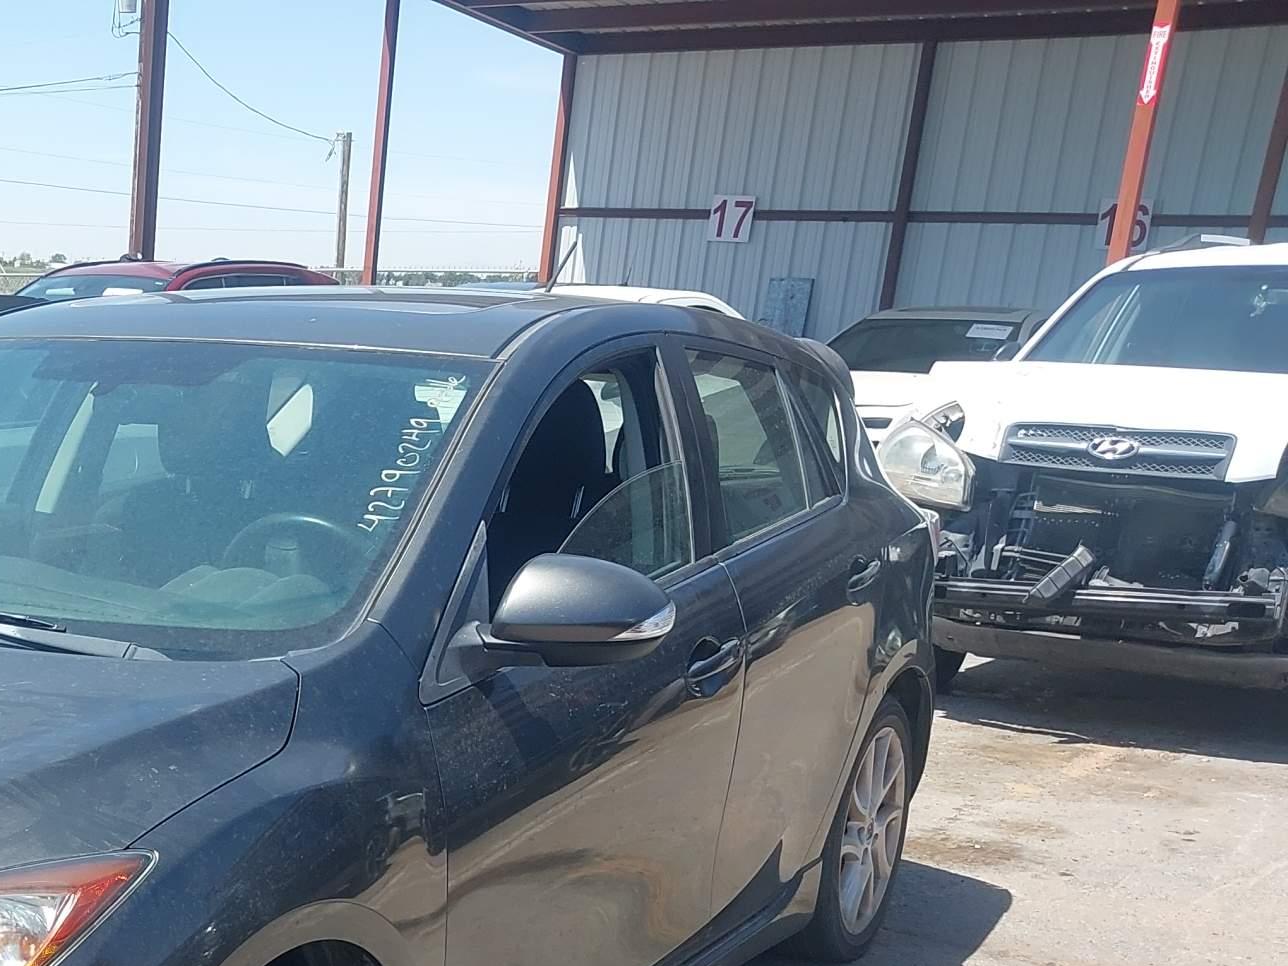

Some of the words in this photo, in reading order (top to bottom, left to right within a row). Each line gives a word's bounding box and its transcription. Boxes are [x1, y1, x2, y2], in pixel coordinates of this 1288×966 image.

[1152, 30, 1167, 39] FIRE
[713, 199, 754, 238] 17
[1101, 203, 1150, 247] 16
[357, 418, 441, 532] 42790249
